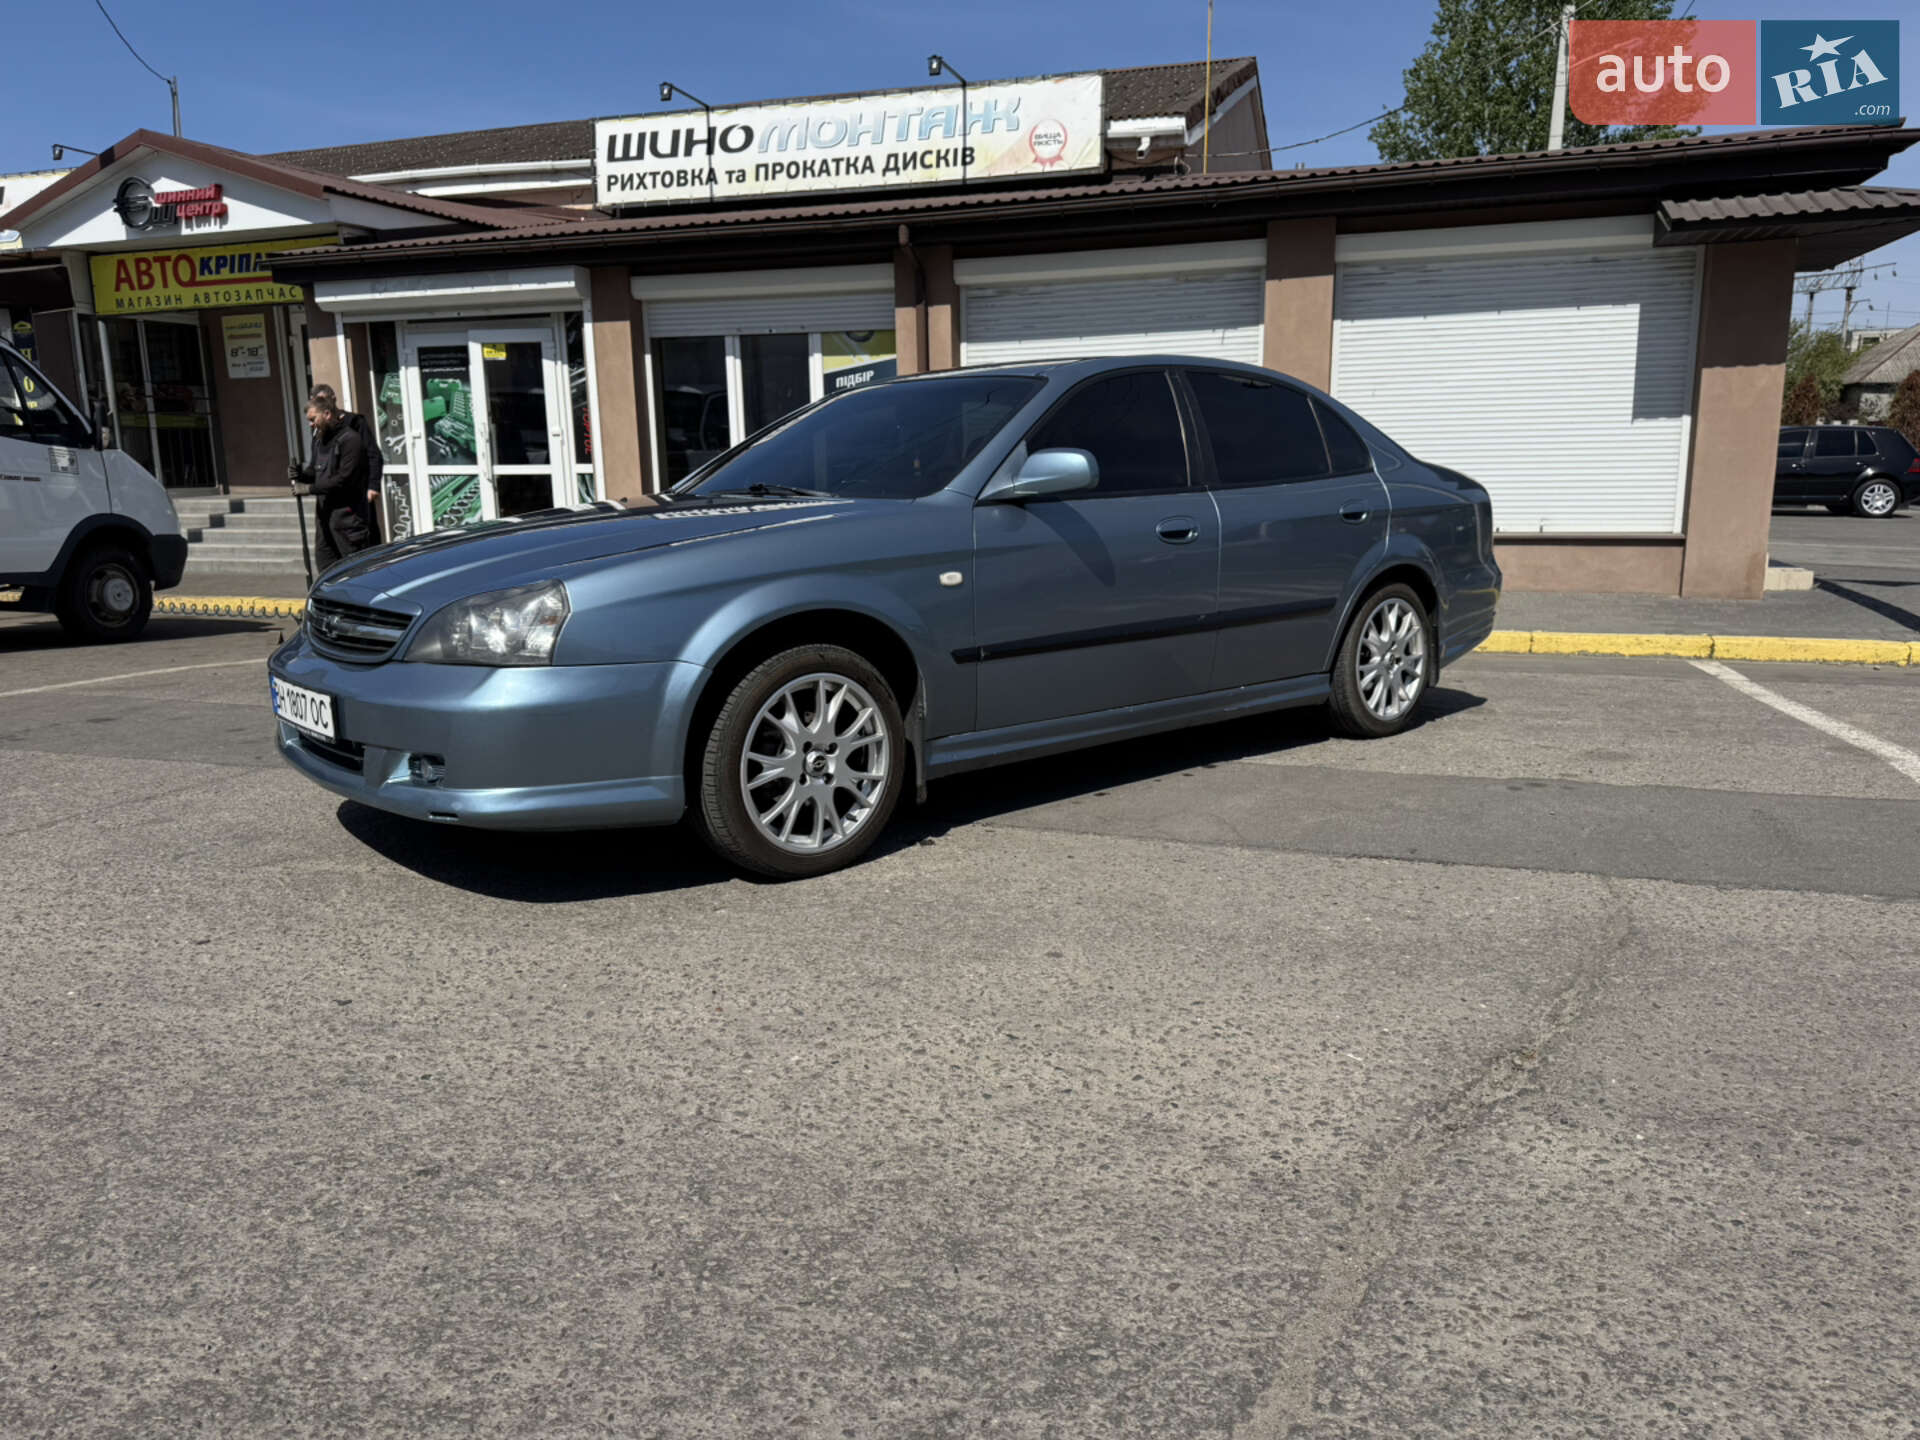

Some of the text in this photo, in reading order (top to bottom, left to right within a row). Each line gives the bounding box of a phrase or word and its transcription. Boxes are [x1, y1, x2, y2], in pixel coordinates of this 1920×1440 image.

[607, 146, 975, 192] РИХТОВКА та ПРОКАТКА ДИСКІВ
[115, 294, 183, 309] МАГАЗИН
[836, 370, 874, 388] ПІДБІР
[311, 697, 329, 729] OC
